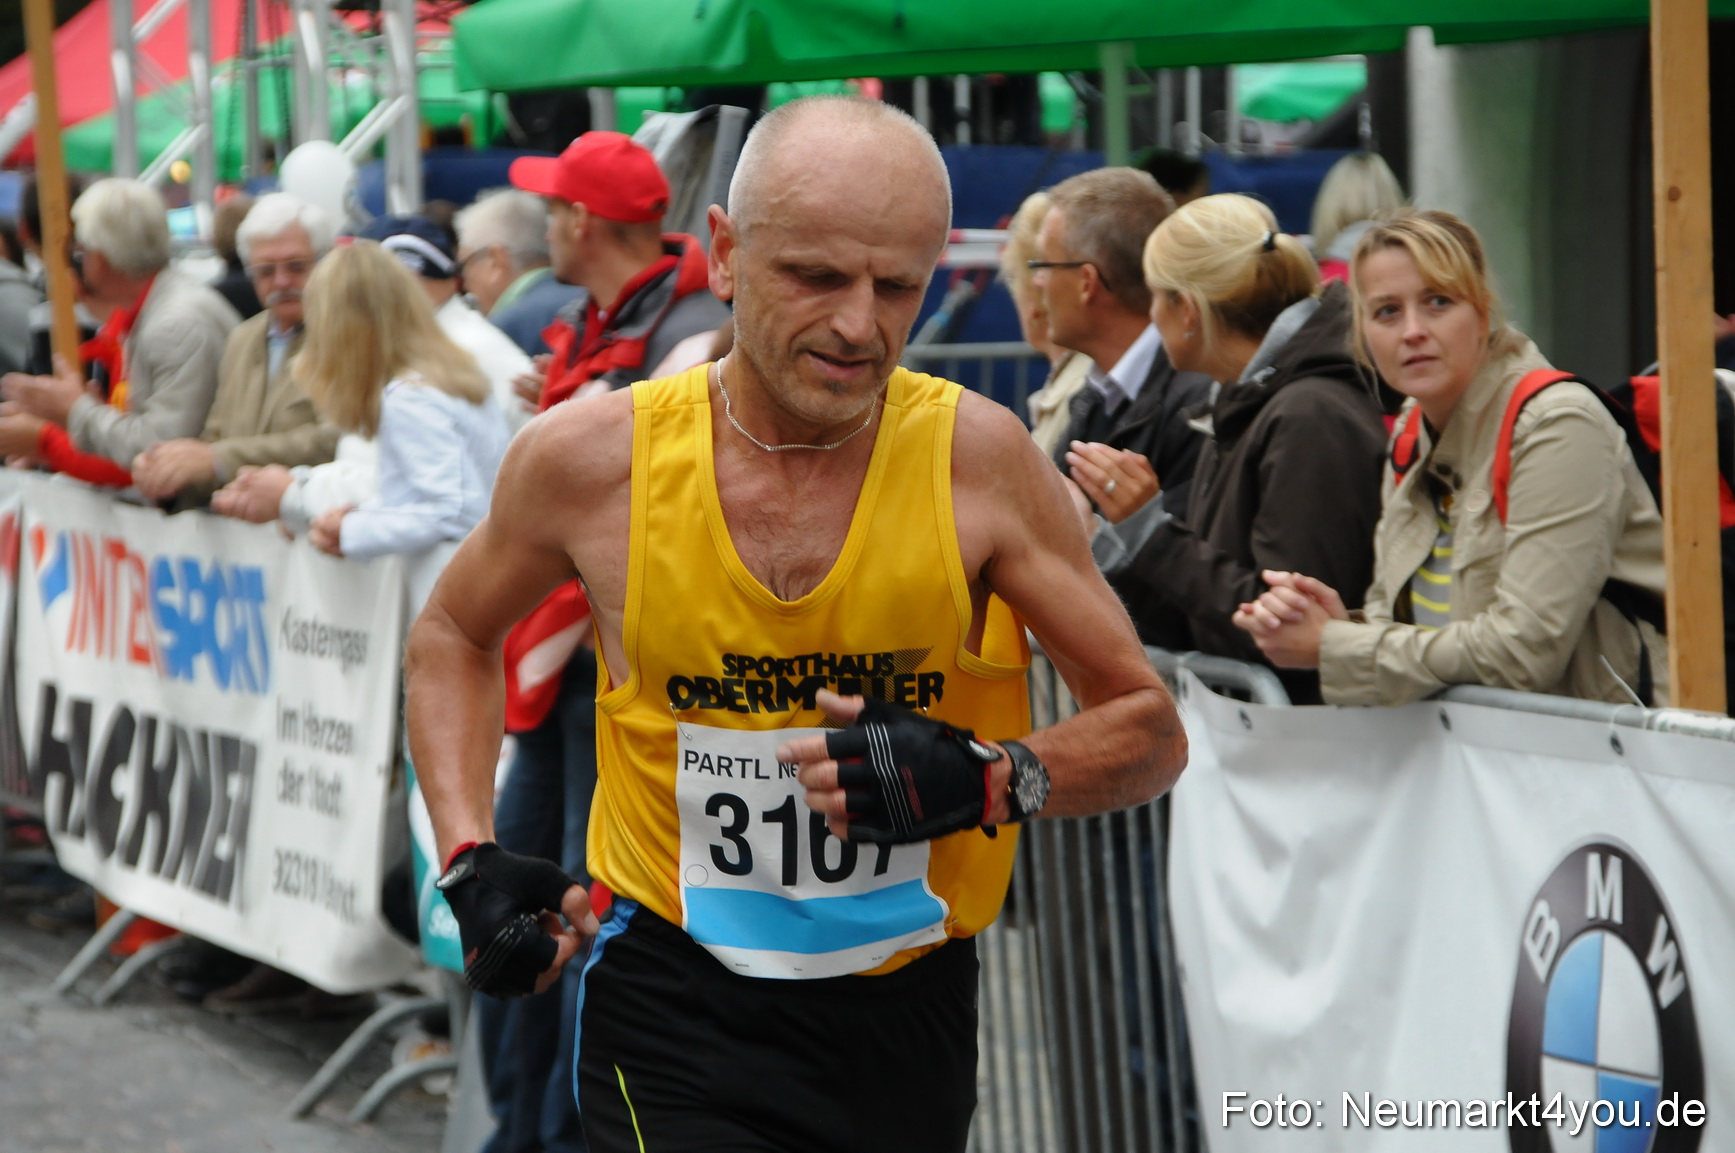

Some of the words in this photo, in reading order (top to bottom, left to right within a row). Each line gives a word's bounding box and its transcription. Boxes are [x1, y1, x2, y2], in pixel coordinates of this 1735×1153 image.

[722, 651, 895, 678] SPORTHAUS
[683, 749, 771, 780] PARTL
[1523, 852, 1687, 1009] BMW
